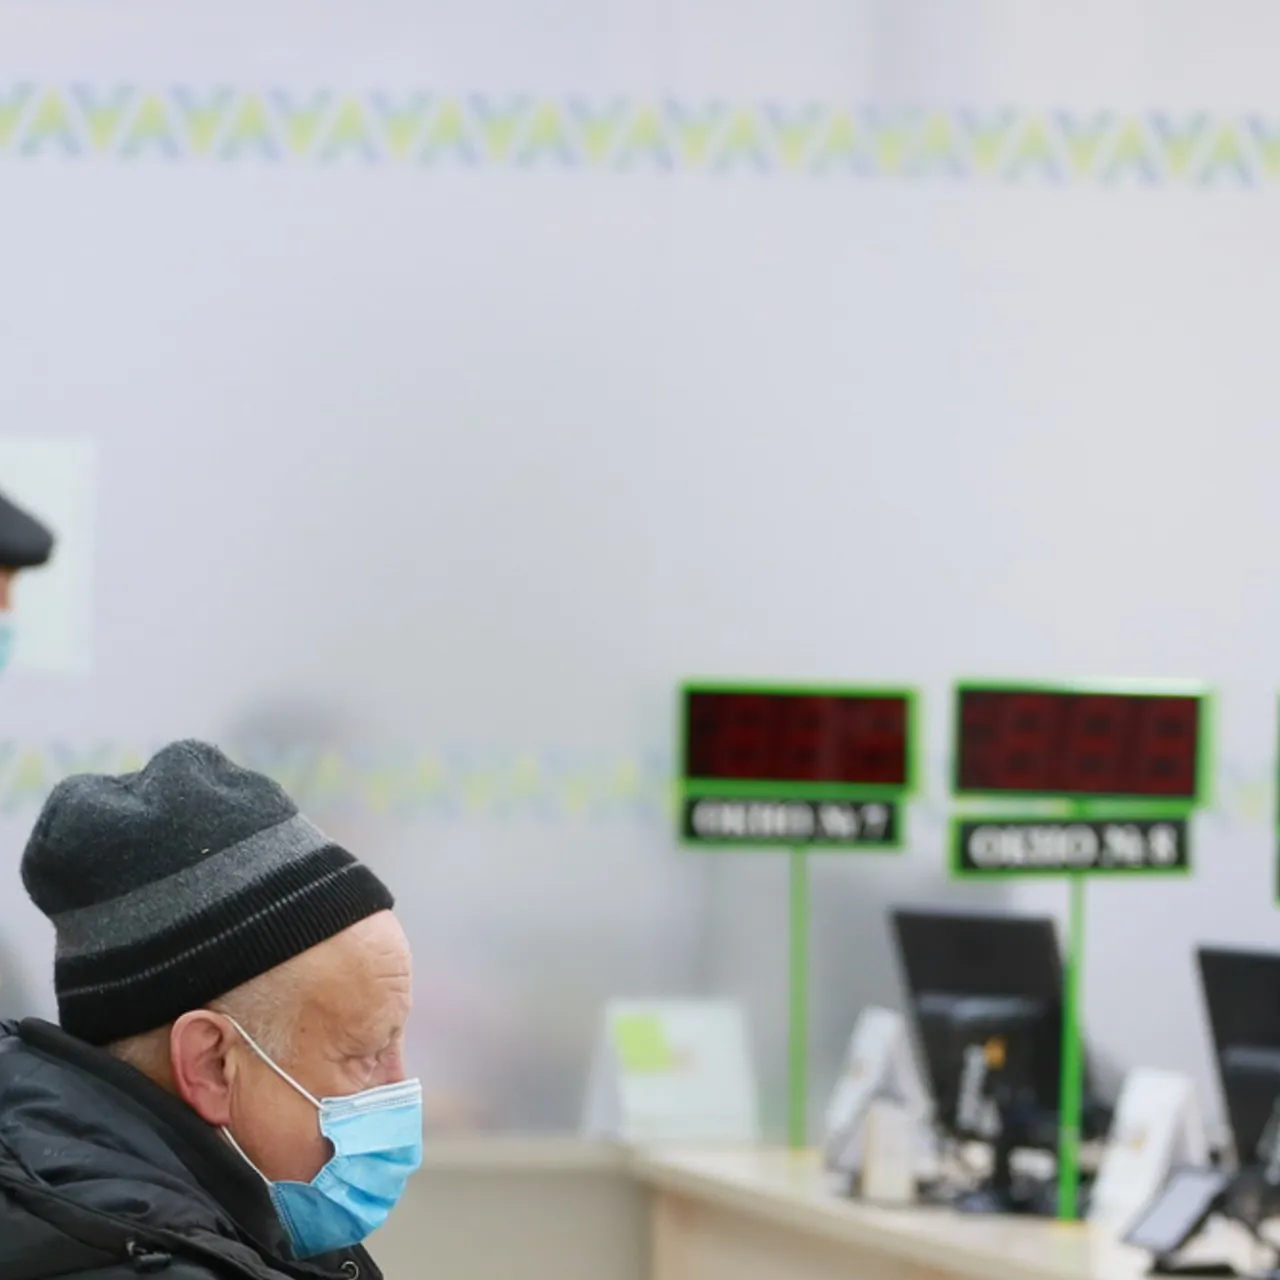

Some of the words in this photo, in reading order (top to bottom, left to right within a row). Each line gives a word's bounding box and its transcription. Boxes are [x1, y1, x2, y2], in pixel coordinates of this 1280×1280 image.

[693, 802, 814, 838] ОКНО
[864, 803, 886, 837] 7
[969, 824, 1099, 867] ОКНО
[1149, 825, 1176, 866] 8
